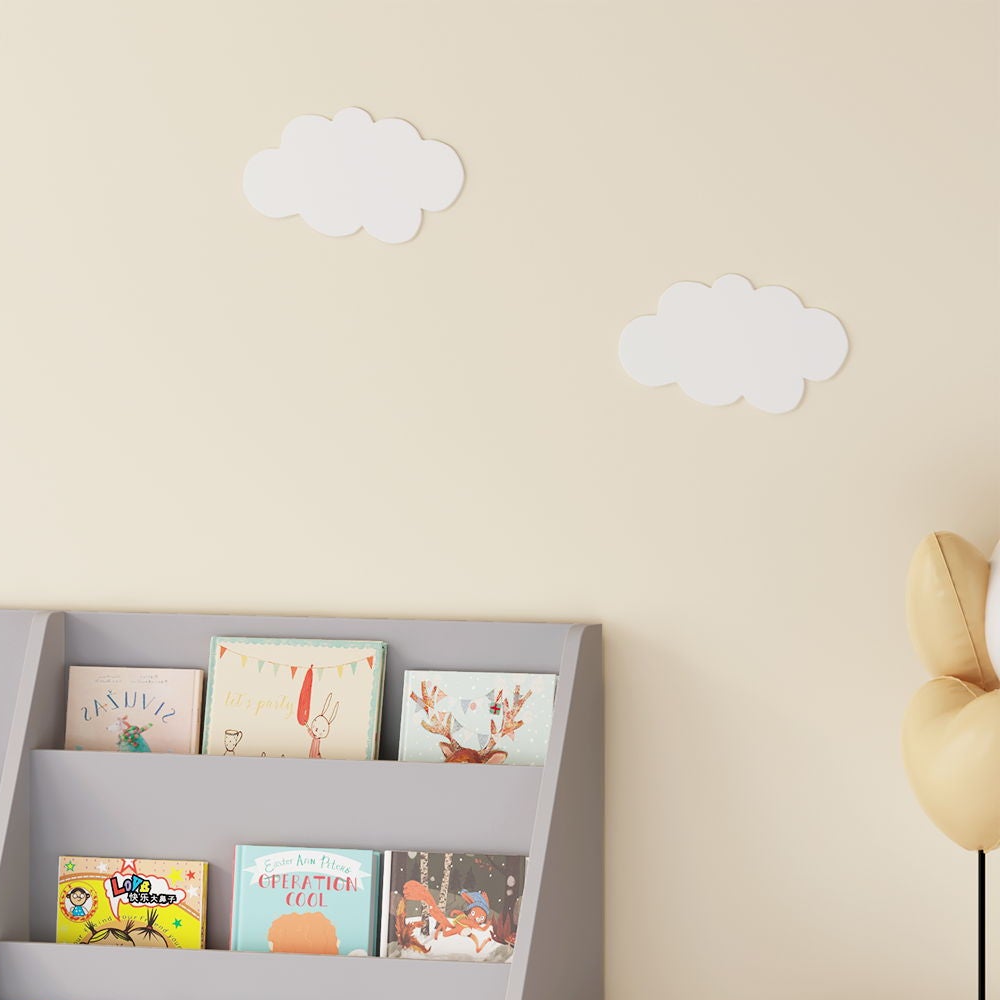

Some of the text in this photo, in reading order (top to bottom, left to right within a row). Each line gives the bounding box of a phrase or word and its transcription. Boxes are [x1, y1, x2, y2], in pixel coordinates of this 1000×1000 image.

[255, 695, 294, 720] party
[296, 854, 316, 866] Ann
[258, 873, 358, 892] OPERATION
[128, 892, 178, 904] 快乐大鼻子
[285, 891, 328, 908] COOL
